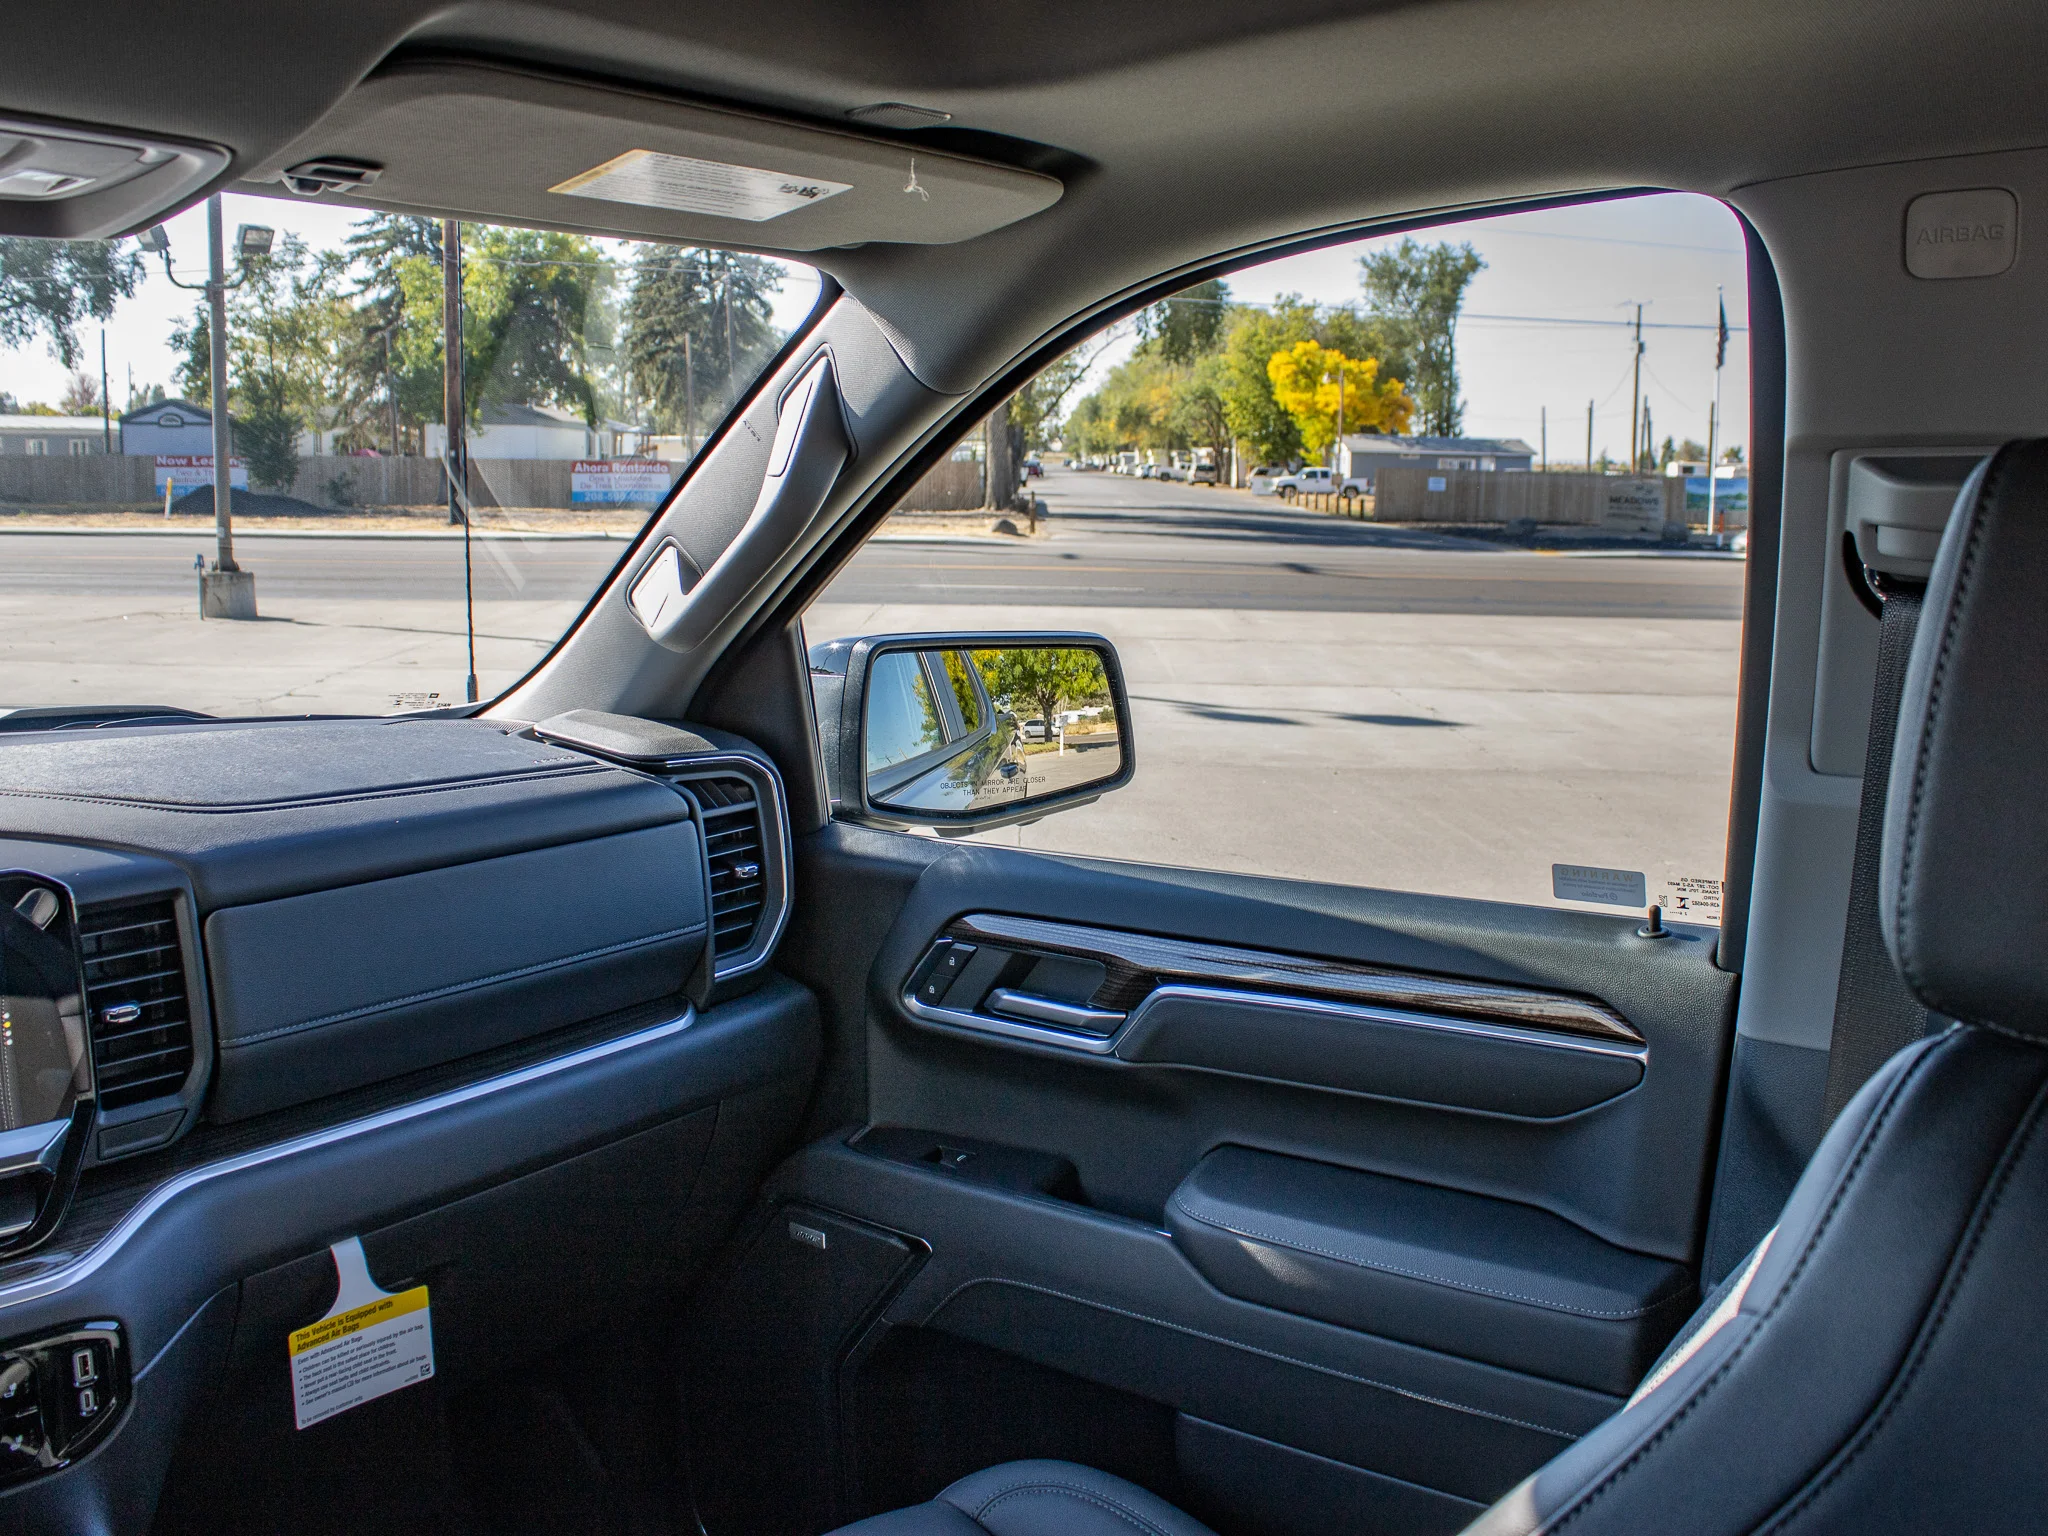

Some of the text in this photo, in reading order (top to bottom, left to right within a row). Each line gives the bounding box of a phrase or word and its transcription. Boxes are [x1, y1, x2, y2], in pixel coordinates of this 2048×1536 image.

[1917, 225, 2005, 244] AIRBAG
[156, 456, 187, 466] Now
[574, 462, 668, 472] Ahora Rentando
[1610, 496, 1658, 504] MEADOWS
[940, 781, 968, 790] OBJECTS
[1002, 785, 1026, 793] APPEAR
[296, 1332, 310, 1342] This
[312, 1322, 336, 1335] Vehicle
[345, 1306, 376, 1323] Equipped
[378, 1301, 393, 1311] with
[297, 1323, 359, 1352] Advanced Air Bags
[298, 1357, 309, 1365] Even
[321, 1342, 343, 1355] Advanced
[302, 1362, 321, 1373] Children
[337, 1350, 349, 1358] killed
[356, 1341, 376, 1352] seriously
[376, 1334, 392, 1344] injured
[358, 1351, 370, 1359] place
[304, 1380, 316, 1389] Never
[329, 1366, 352, 1378] rear-facing
[352, 1361, 363, 1369] child
[305, 1388, 320, 1397] Always
[358, 1367, 369, 1375] child
[314, 1391, 331, 1401] owner's
[373, 1365, 396, 1377] information
[397, 1360, 409, 1368] about
[312, 1409, 330, 1420] removed
